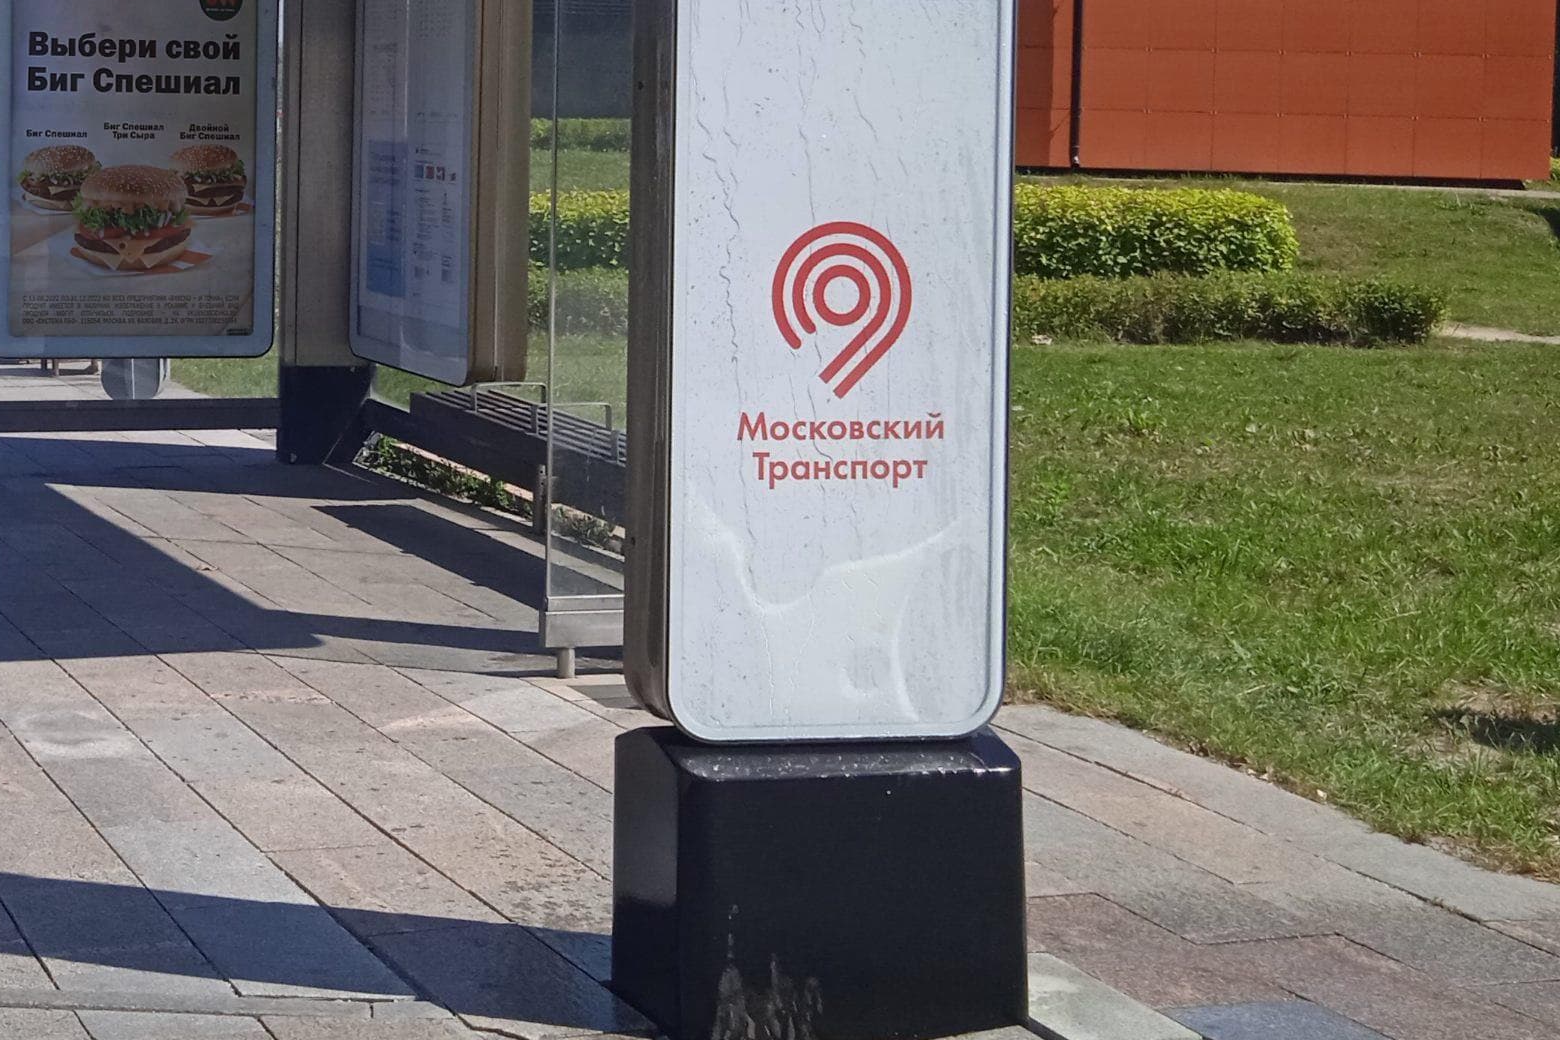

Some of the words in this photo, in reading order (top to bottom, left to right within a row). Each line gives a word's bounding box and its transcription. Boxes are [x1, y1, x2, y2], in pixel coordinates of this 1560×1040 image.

[28, 31, 157, 63] Выбери
[165, 33, 241, 60] свой
[27, 66, 85, 92] Биг
[92, 67, 241, 95] Спешиал
[103, 122, 119, 131] Биг
[122, 122, 165, 132] Спешиал
[189, 123, 230, 133] Двойной
[26, 129, 42, 138] Биг
[45, 129, 88, 139] Спешиал
[112, 131, 128, 141] Три
[130, 131, 155, 141] Сыра
[179, 132, 196, 141] Биг
[198, 132, 241, 141] Спешиал
[737, 411, 945, 441] Московский
[752, 451, 928, 489] Транспорт
